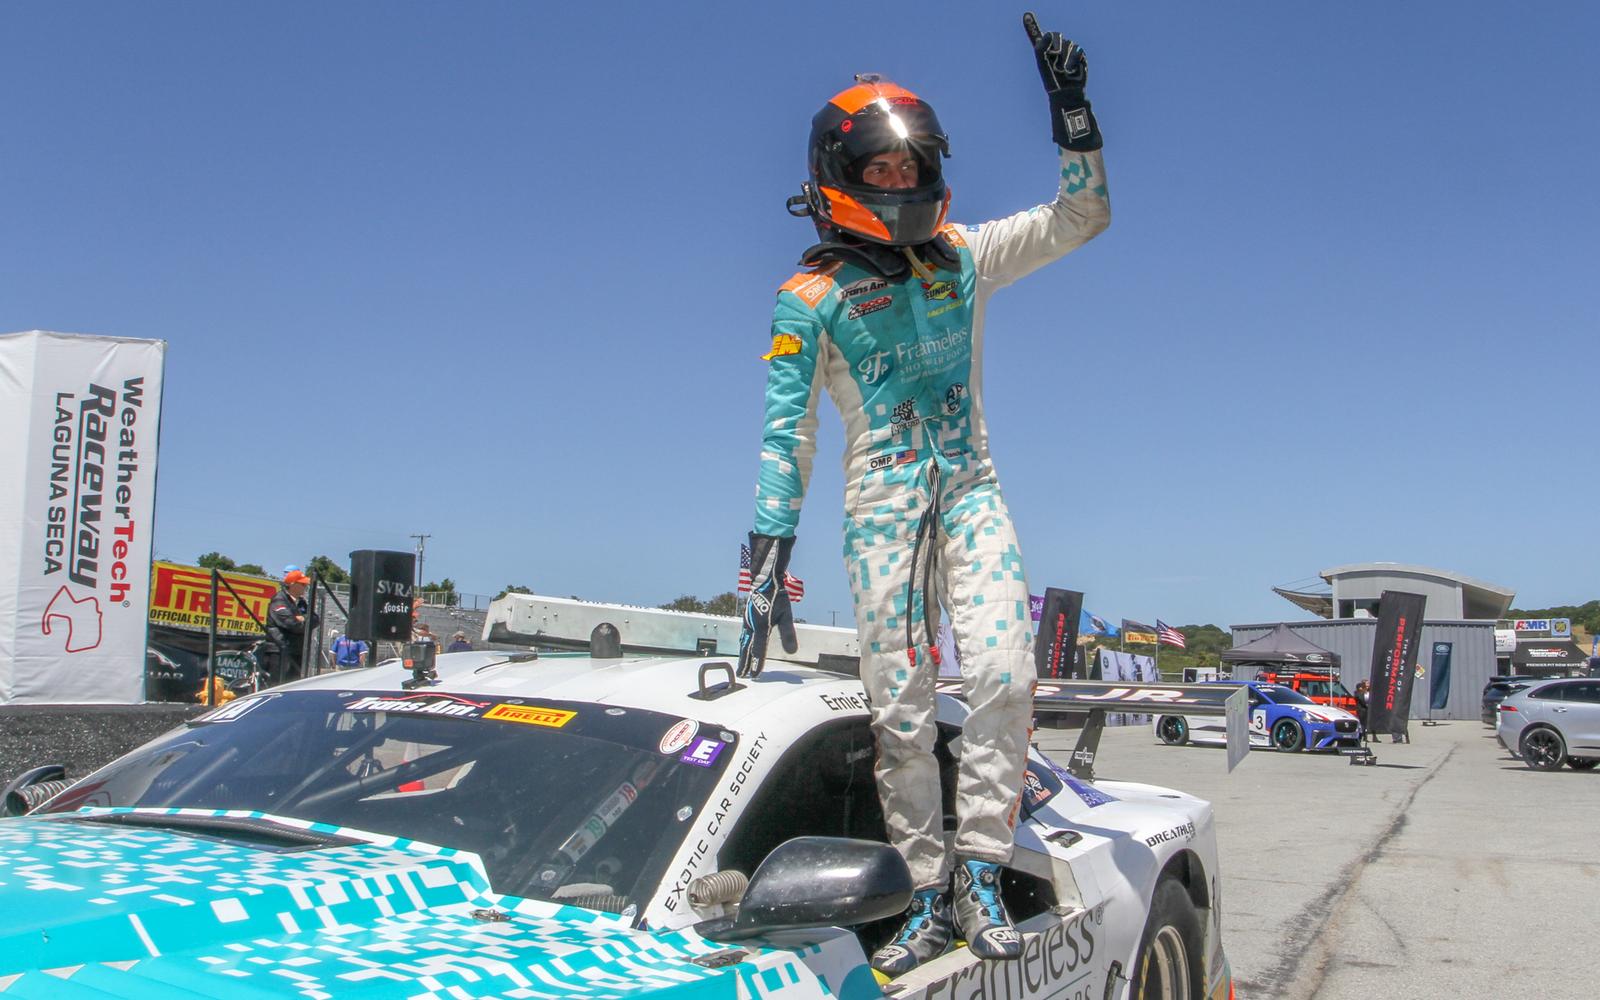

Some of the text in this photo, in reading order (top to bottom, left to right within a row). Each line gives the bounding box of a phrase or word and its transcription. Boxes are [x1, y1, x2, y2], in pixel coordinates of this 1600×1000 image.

[895, 327, 968, 363] Frameless
[870, 456, 893, 469] OMP
[44, 392, 75, 576] LAGUNA SECA
[69, 383, 117, 589] Raceway
[153, 567, 278, 621] PIRELL
[376, 580, 414, 598] SVRA
[751, 592, 770, 613] OMP
[149, 608, 192, 624] OFFICIAL
[193, 614, 225, 629] STRET
[226, 619, 244, 631] TIRE
[244, 621, 255, 632] OF
[1051, 612, 1066, 679] PERFORMA
[1384, 649, 1393, 677] TOUR
[1385, 616, 1406, 710] PERFORMANCE
[346, 696, 475, 716] Trans Am
[820, 692, 861, 711] Ernie
[494, 706, 568, 723] PIRELLI
[1255, 715, 1264, 730] 3
[691, 739, 720, 760] E
[665, 731, 768, 911] EXOTIC CAR SOCIETY
